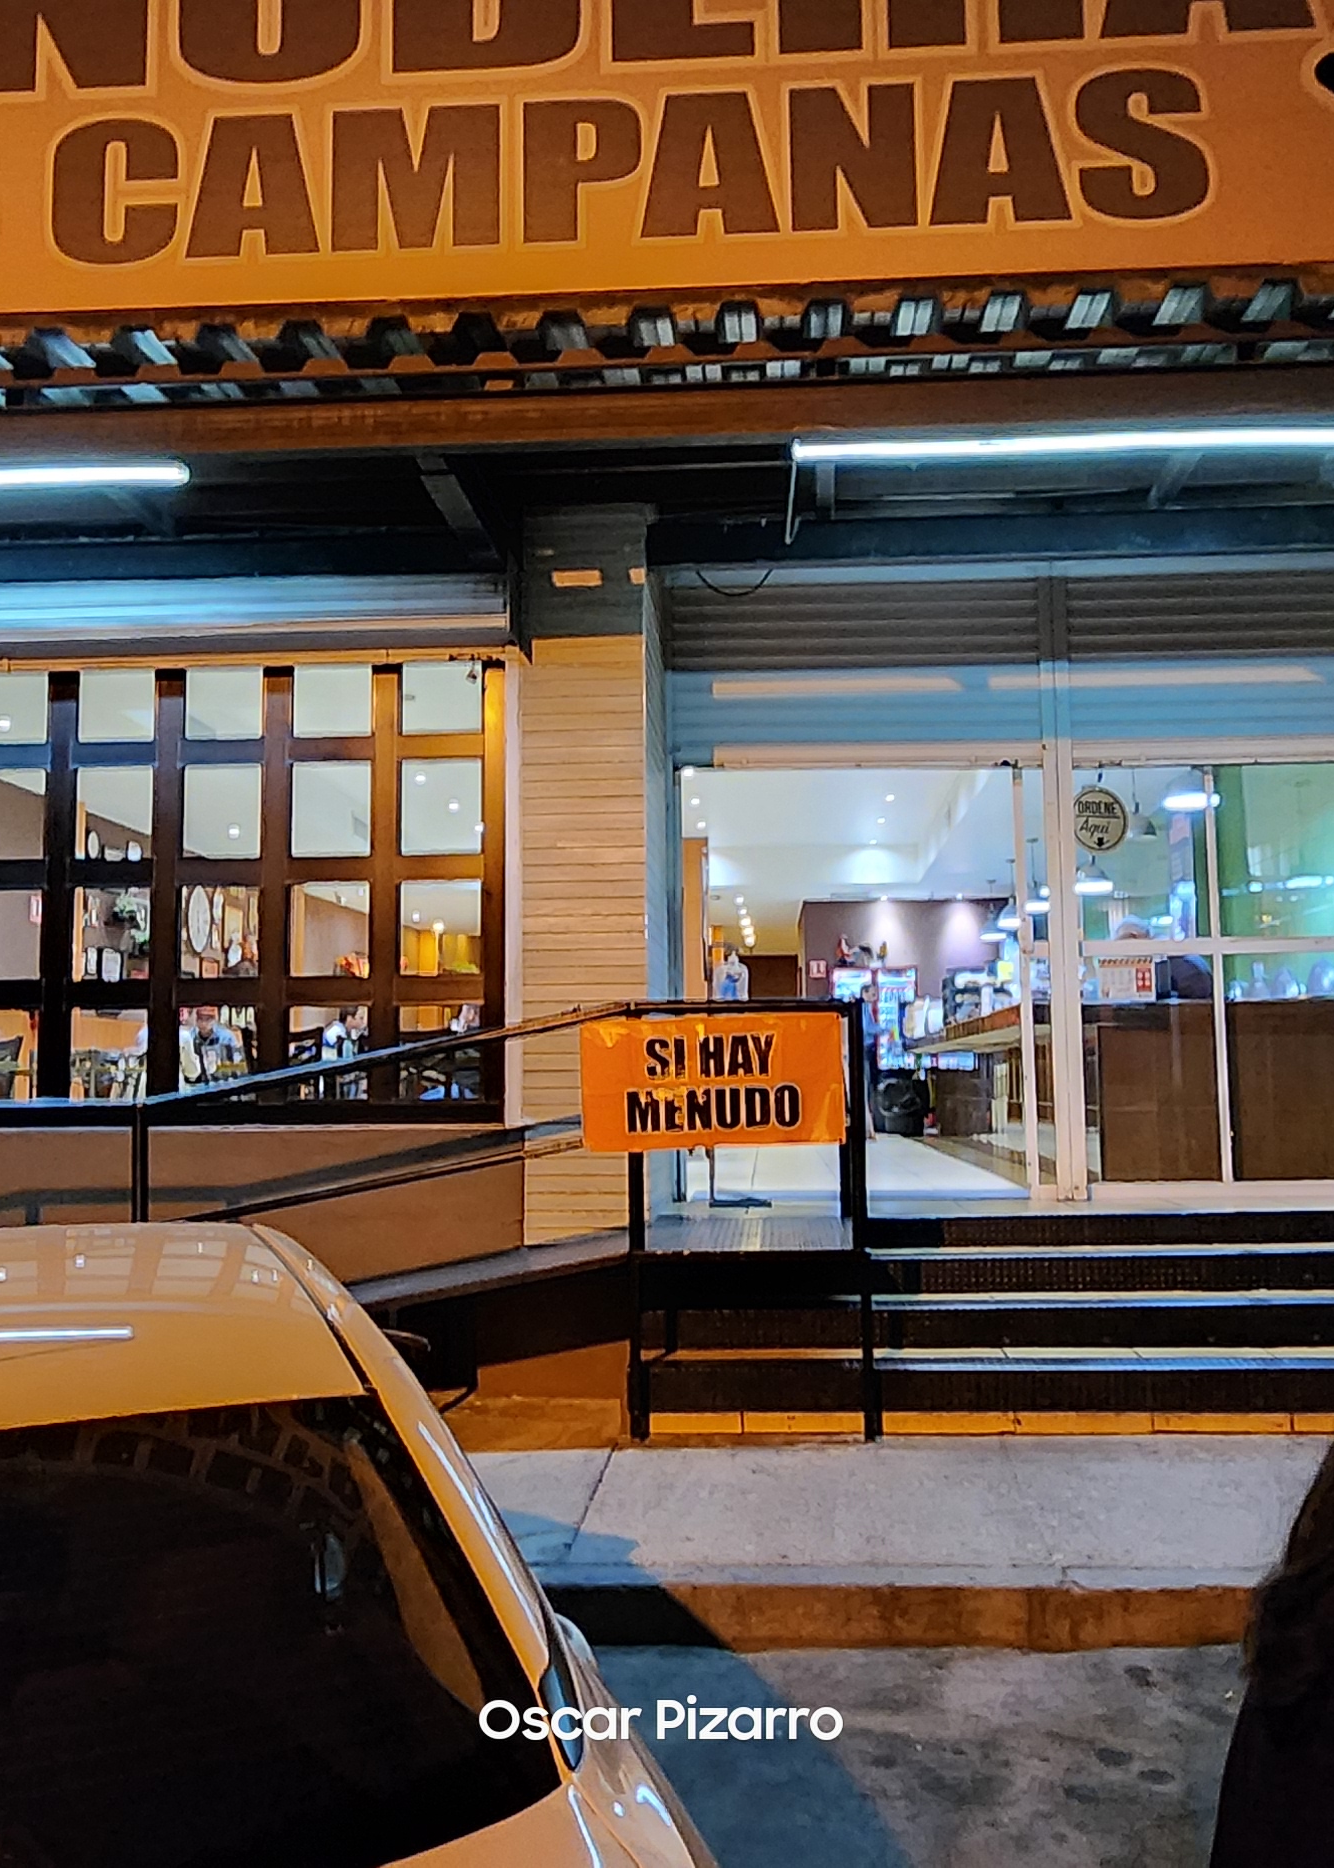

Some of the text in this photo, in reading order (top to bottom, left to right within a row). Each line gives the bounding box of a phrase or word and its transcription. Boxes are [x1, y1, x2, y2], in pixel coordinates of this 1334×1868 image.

[50, 66, 1210, 267] CAMPANAS
[1077, 800, 1118, 815] ORDENE
[644, 1033, 776, 1081] SI HAY
[626, 1084, 801, 1134] MENUDO
